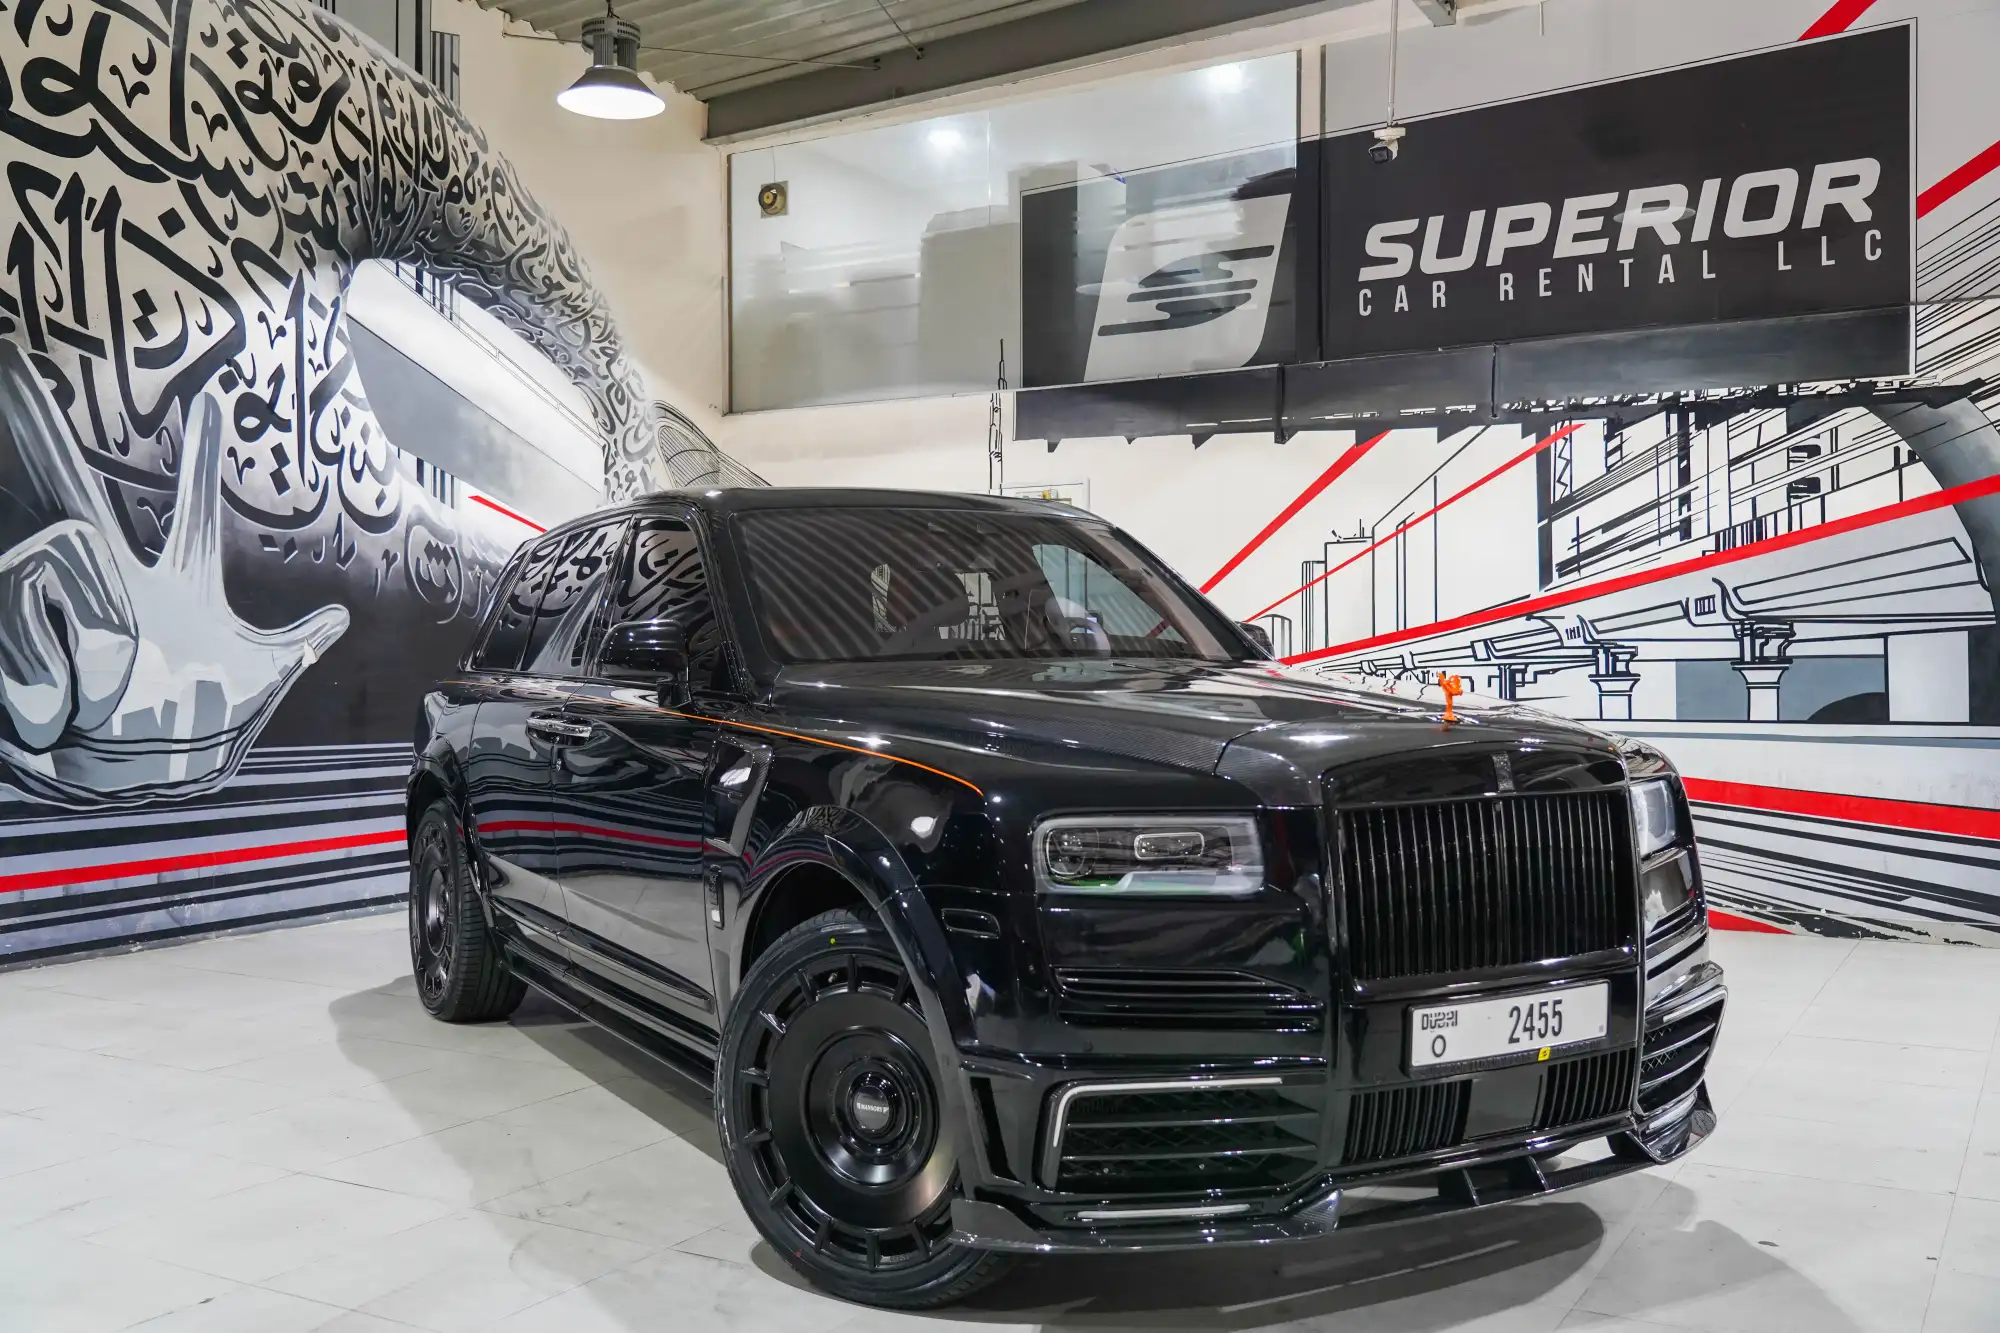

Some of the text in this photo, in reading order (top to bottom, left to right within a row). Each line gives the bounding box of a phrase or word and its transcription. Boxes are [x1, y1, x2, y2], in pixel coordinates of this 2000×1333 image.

[1358, 157, 1881, 282] SUPERIOR
[1359, 229, 1882, 317] CAR RENTAL LLC
[1509, 999, 1563, 1044] 2455
